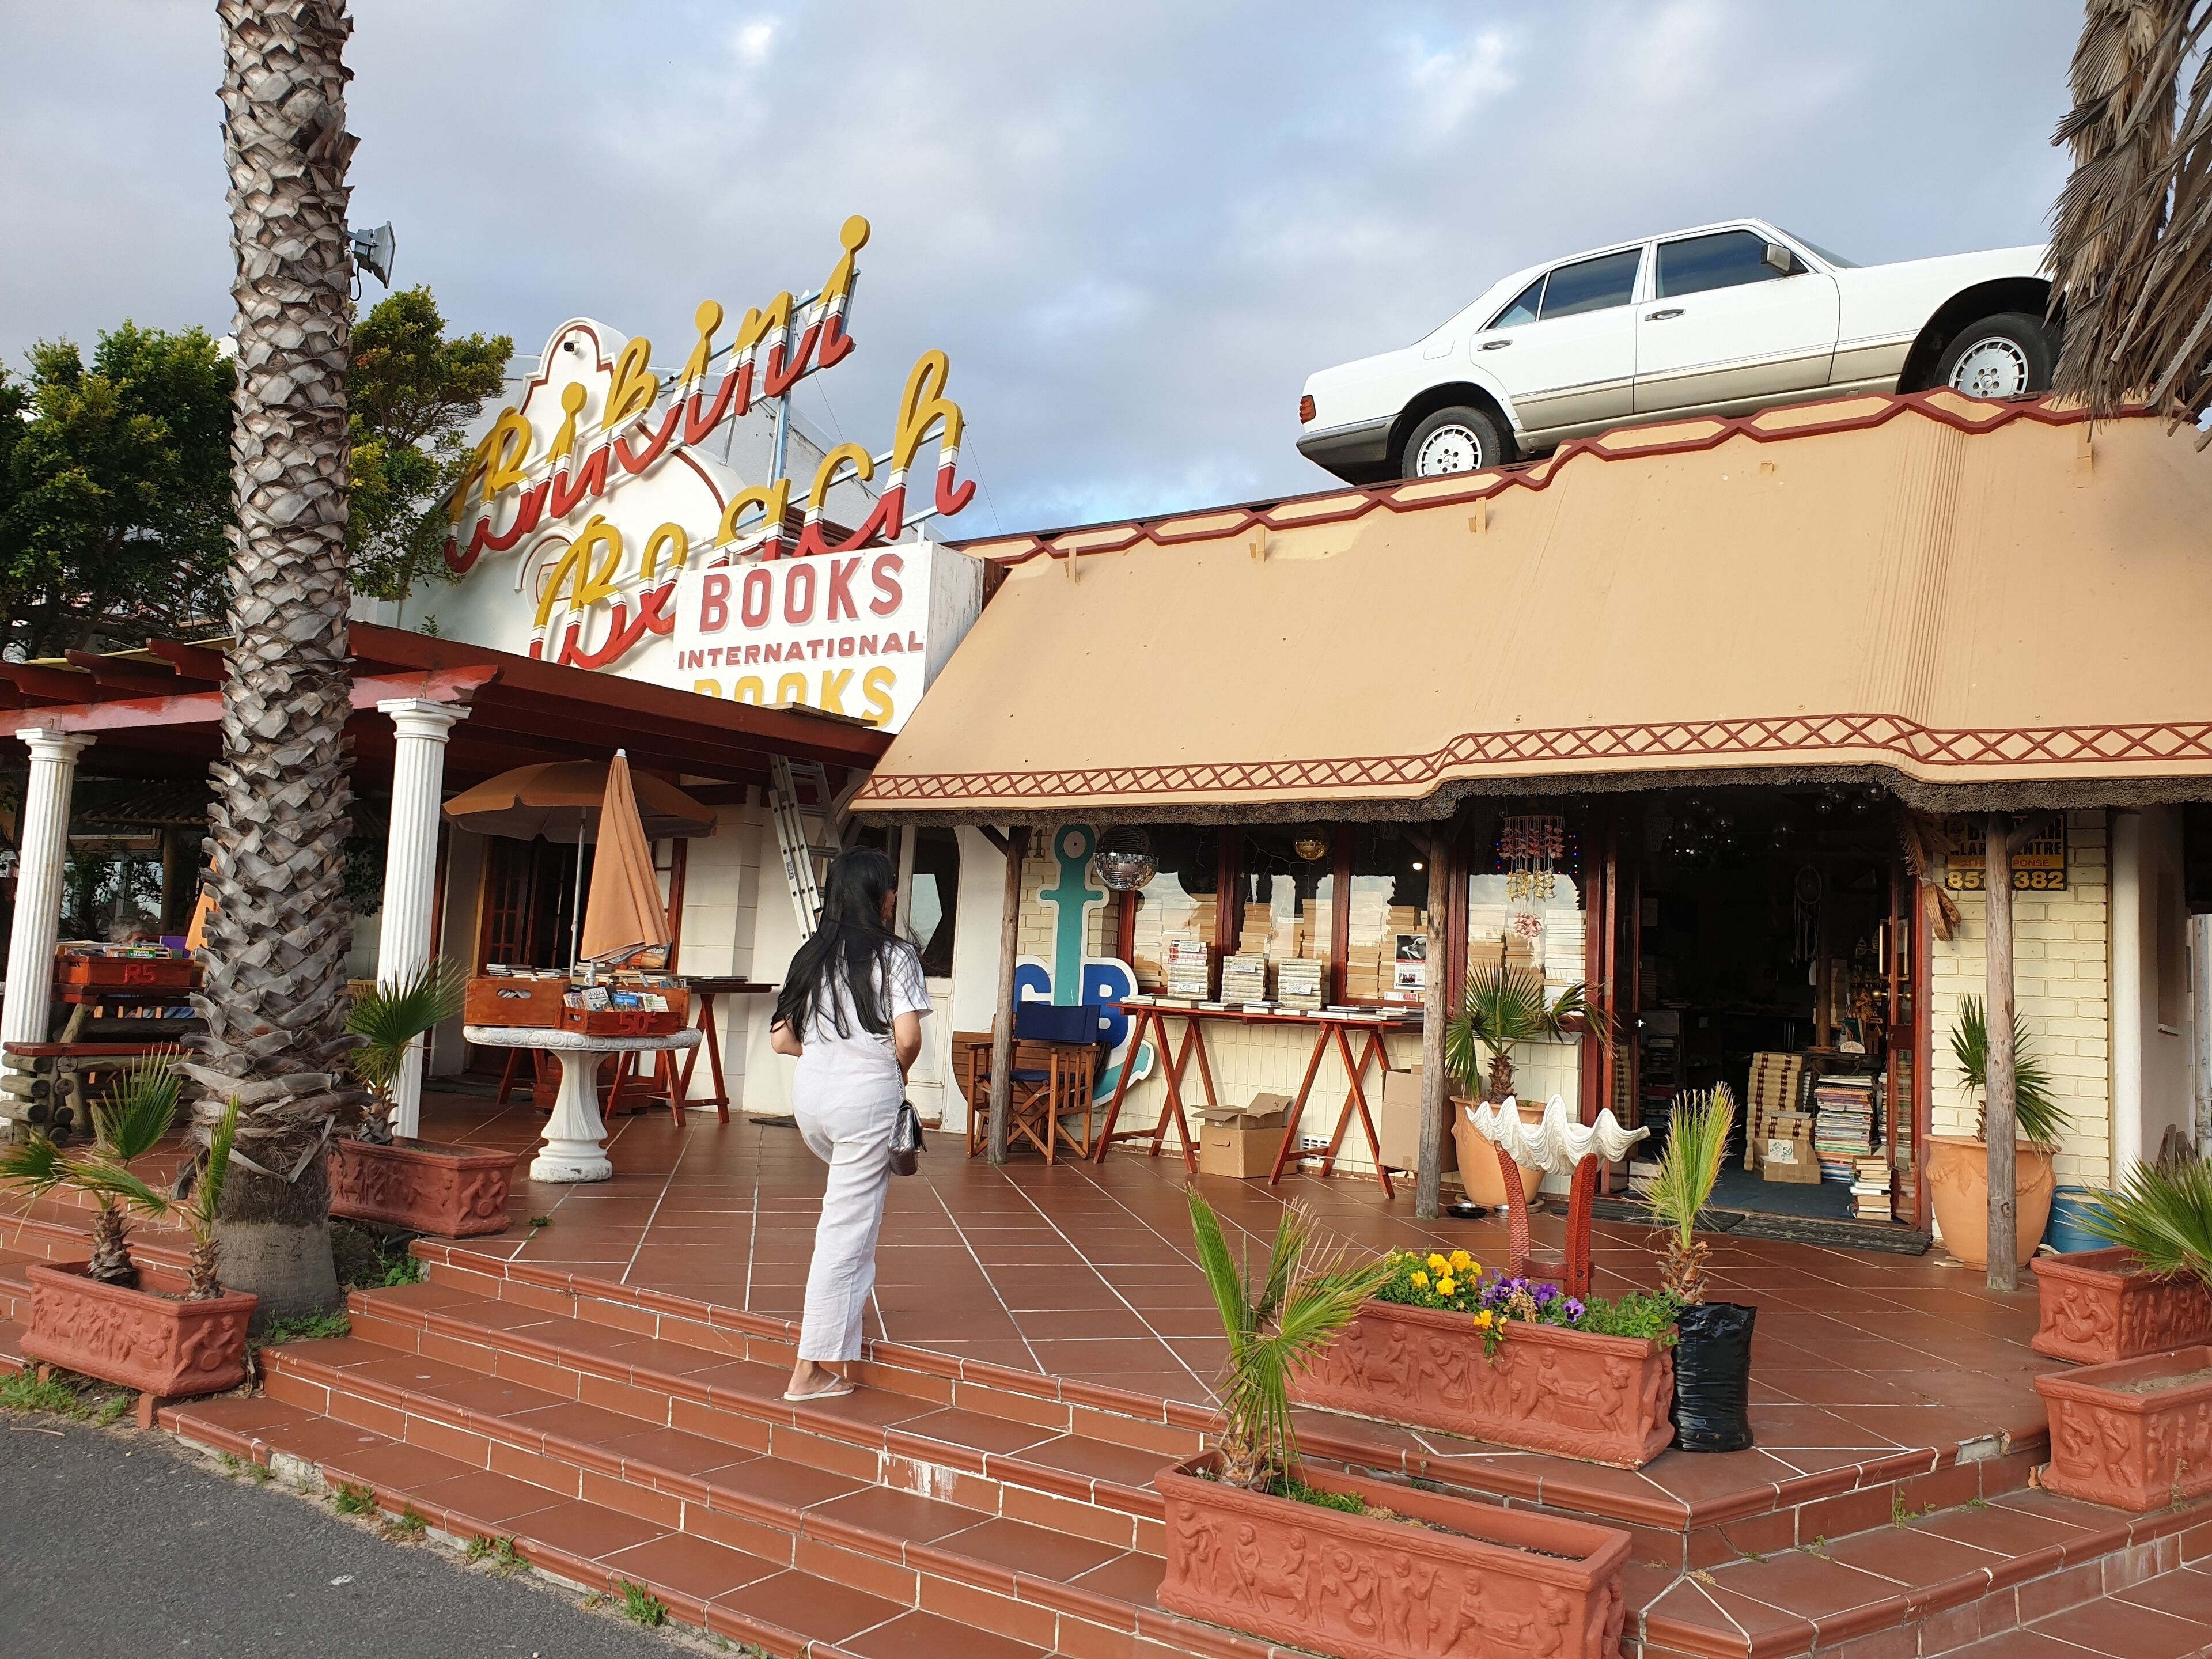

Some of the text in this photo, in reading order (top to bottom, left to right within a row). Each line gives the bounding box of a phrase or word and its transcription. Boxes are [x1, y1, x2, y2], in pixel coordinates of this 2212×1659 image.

[444, 214, 871, 574] Bikini
[531, 349, 976, 669] Beach
[699, 553, 904, 634] BOOKS
[678, 631, 924, 670] INTERNATIONAL
[2014, 870, 2063, 888] 382
[124, 964, 157, 984] R5
